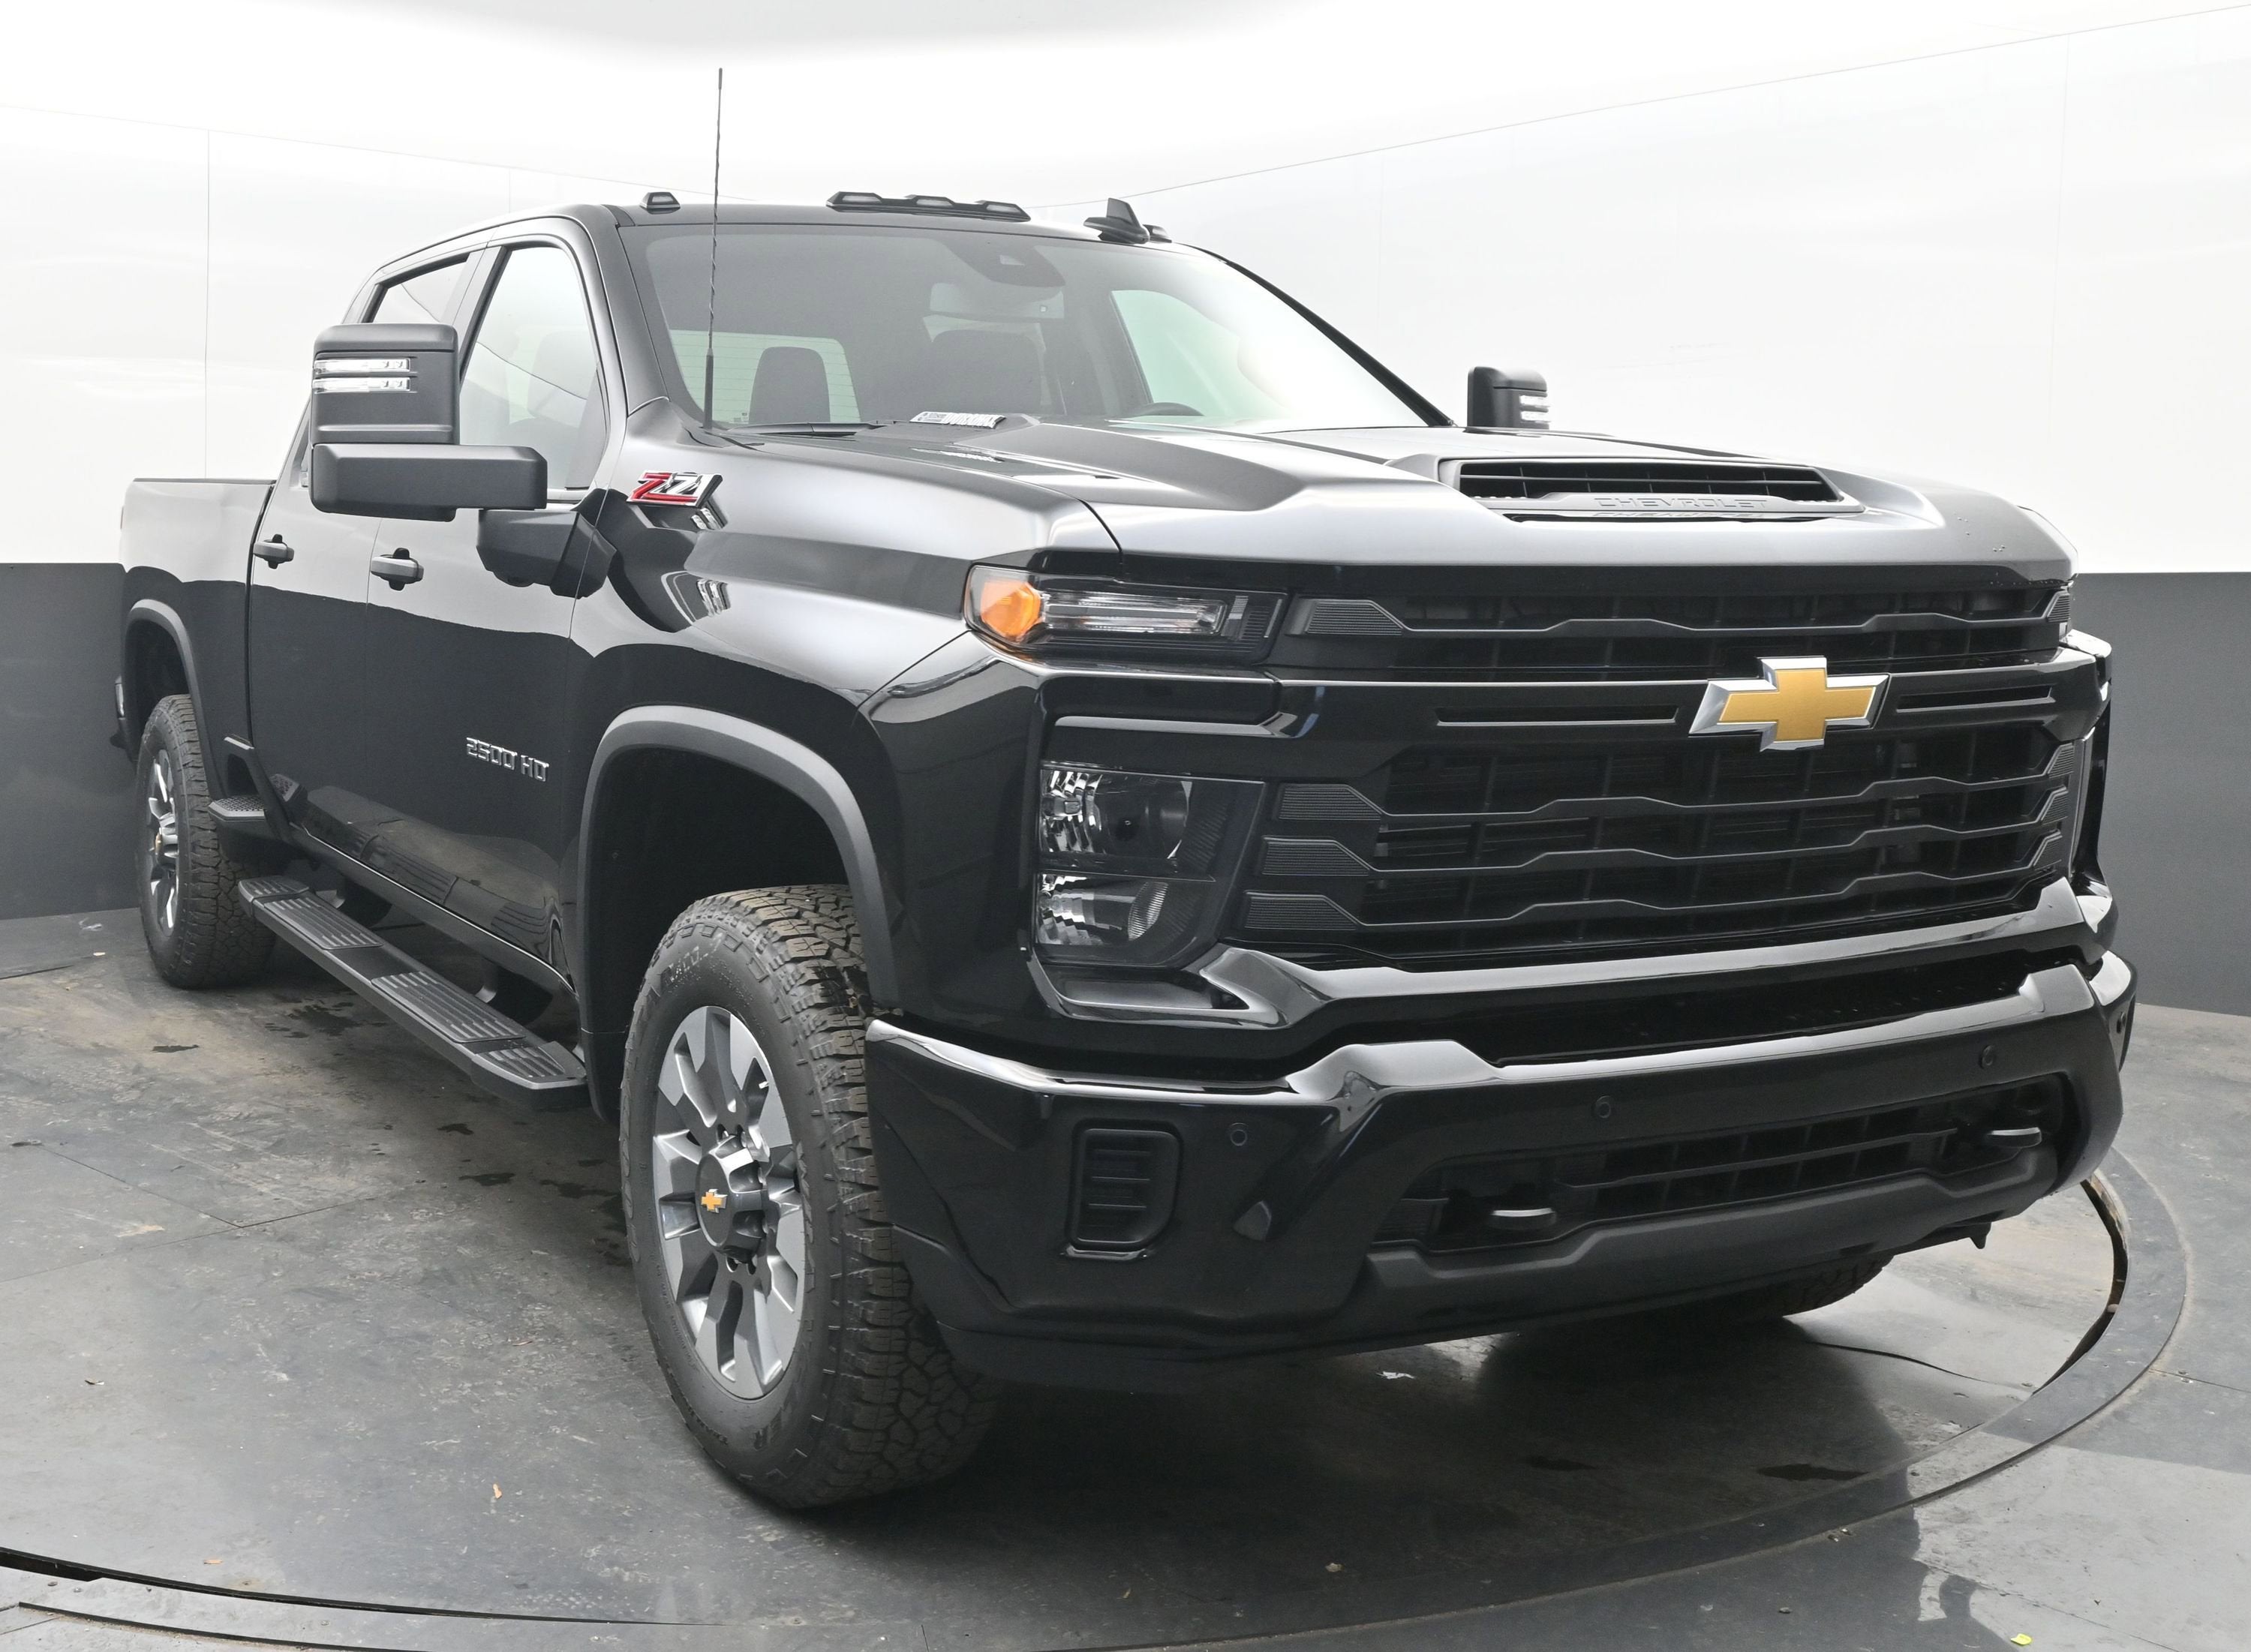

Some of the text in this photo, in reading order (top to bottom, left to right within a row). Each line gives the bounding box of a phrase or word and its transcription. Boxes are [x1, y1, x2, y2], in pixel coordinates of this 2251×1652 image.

[627, 470, 723, 507] Z71
[1593, 497, 1767, 509] CHEVROLET
[466, 737, 550, 782] 2500 HD
